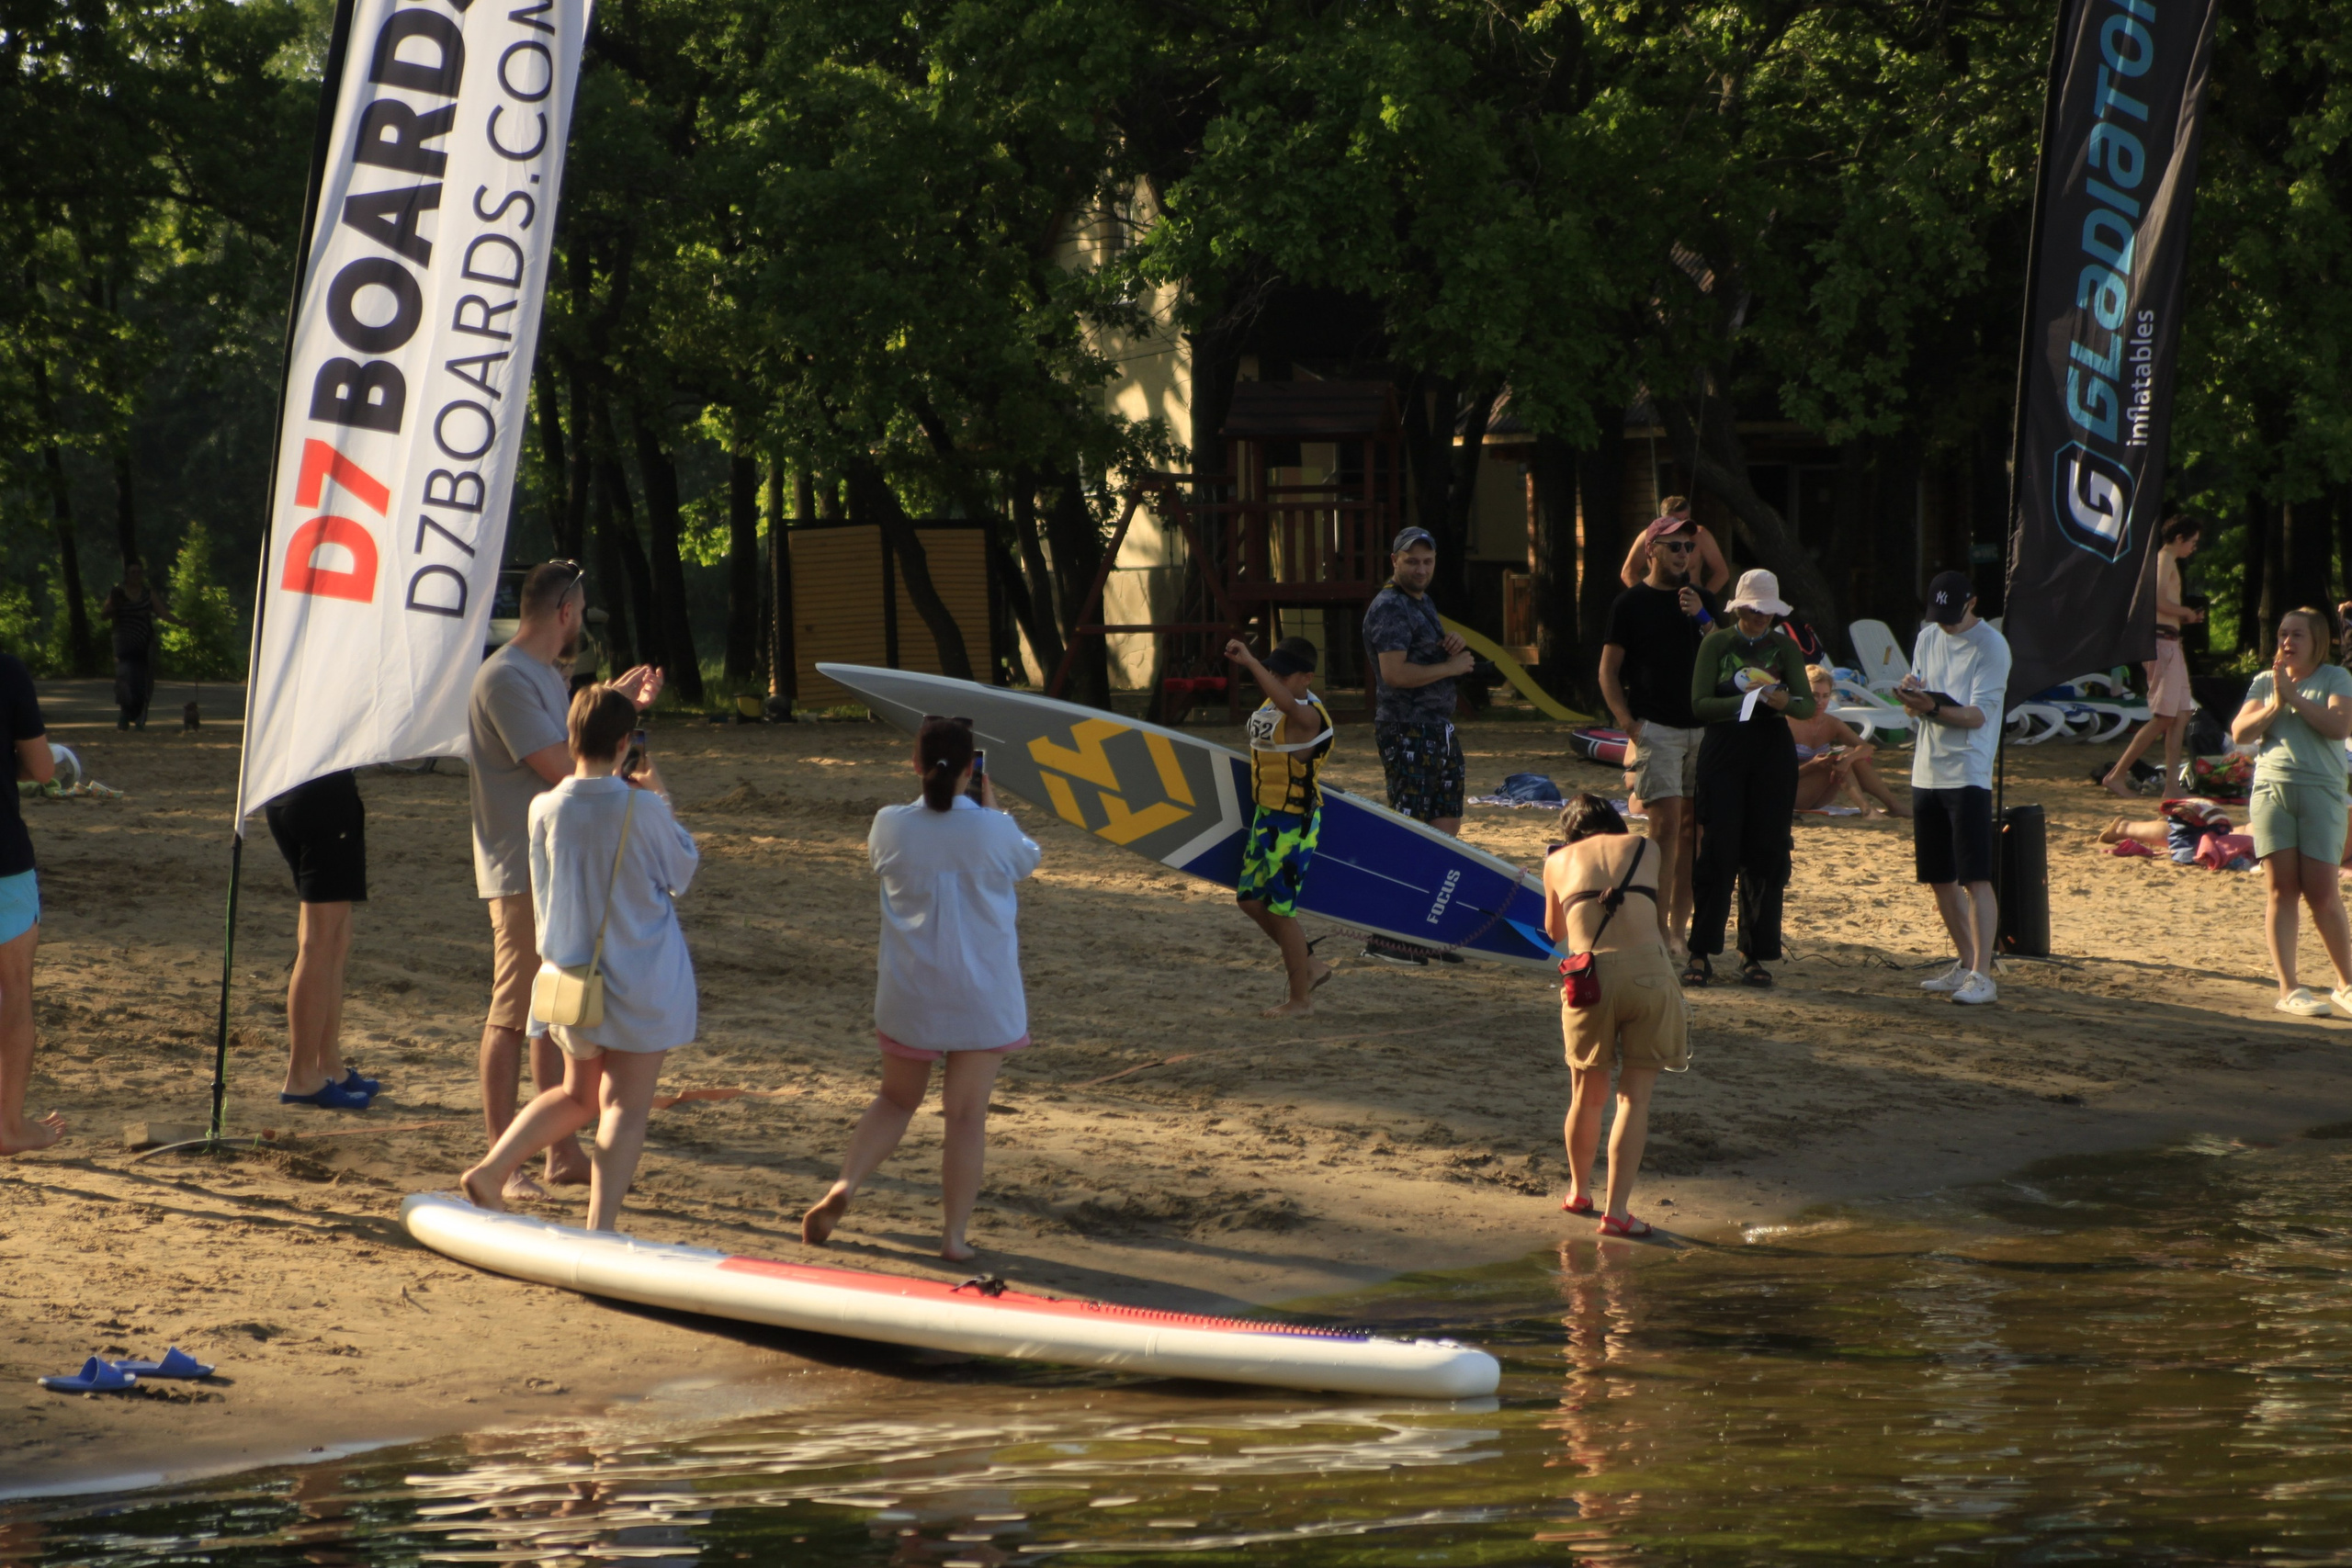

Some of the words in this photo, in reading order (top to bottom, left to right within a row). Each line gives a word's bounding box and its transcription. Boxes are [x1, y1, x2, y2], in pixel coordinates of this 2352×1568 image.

[309, 0, 474, 435] BOARD
[2126, 310, 2154, 446] inflatables
[1426, 869, 1461, 925] FOCUS
